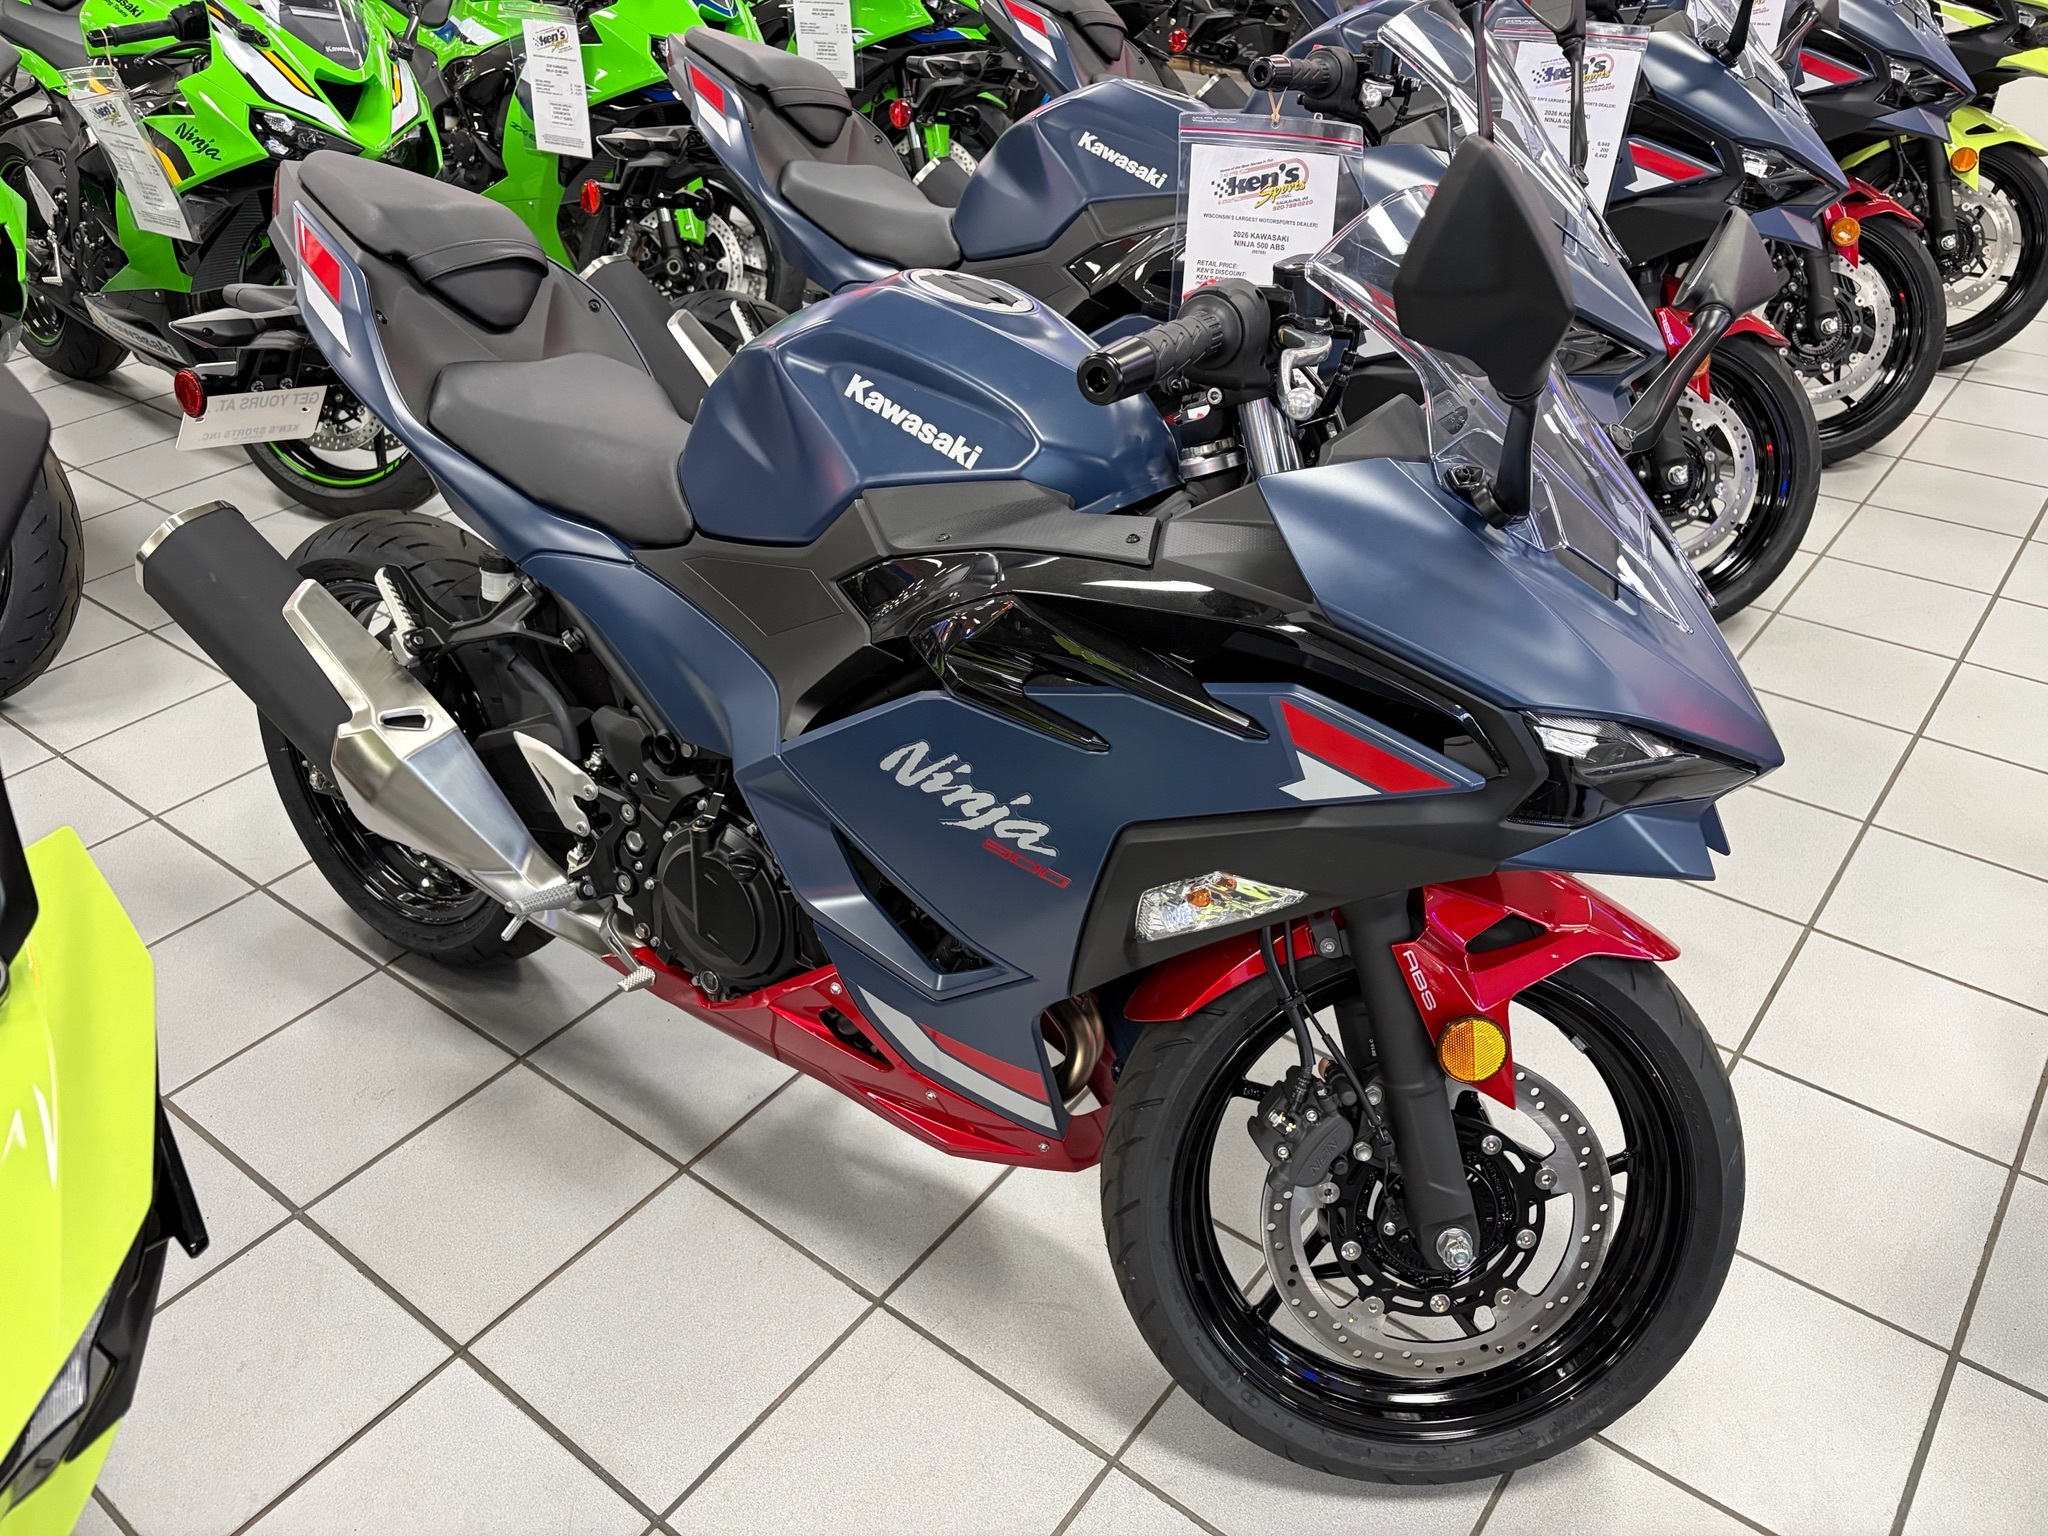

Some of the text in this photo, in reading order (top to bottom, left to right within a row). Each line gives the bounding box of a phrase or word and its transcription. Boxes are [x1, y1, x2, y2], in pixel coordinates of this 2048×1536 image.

[115, 0, 145, 18] saki
[174, 121, 222, 161] Ninja
[1077, 130, 1169, 189] Kawasaki
[1254, 180, 1307, 209] Sports
[1203, 212, 1235, 221] WISCONSIN'S
[1235, 215, 1258, 223] LARGEST
[1258, 218, 1296, 226] MOTORSPORTS
[1233, 230, 1290, 242] 2026 KAWASAKI
[1234, 239, 1255, 248] NINJA
[1269, 243, 1286, 251] ABS
[1196, 259, 1217, 268] RETAIL
[1214, 269, 1248, 277] DISCOUNT:
[1659, 310, 1675, 345] ABS
[843, 373, 984, 470] Kawasaki
[879, 741, 1057, 857] Ninja
[982, 838, 1072, 889] 500
[1402, 949, 1437, 1011] ABS
